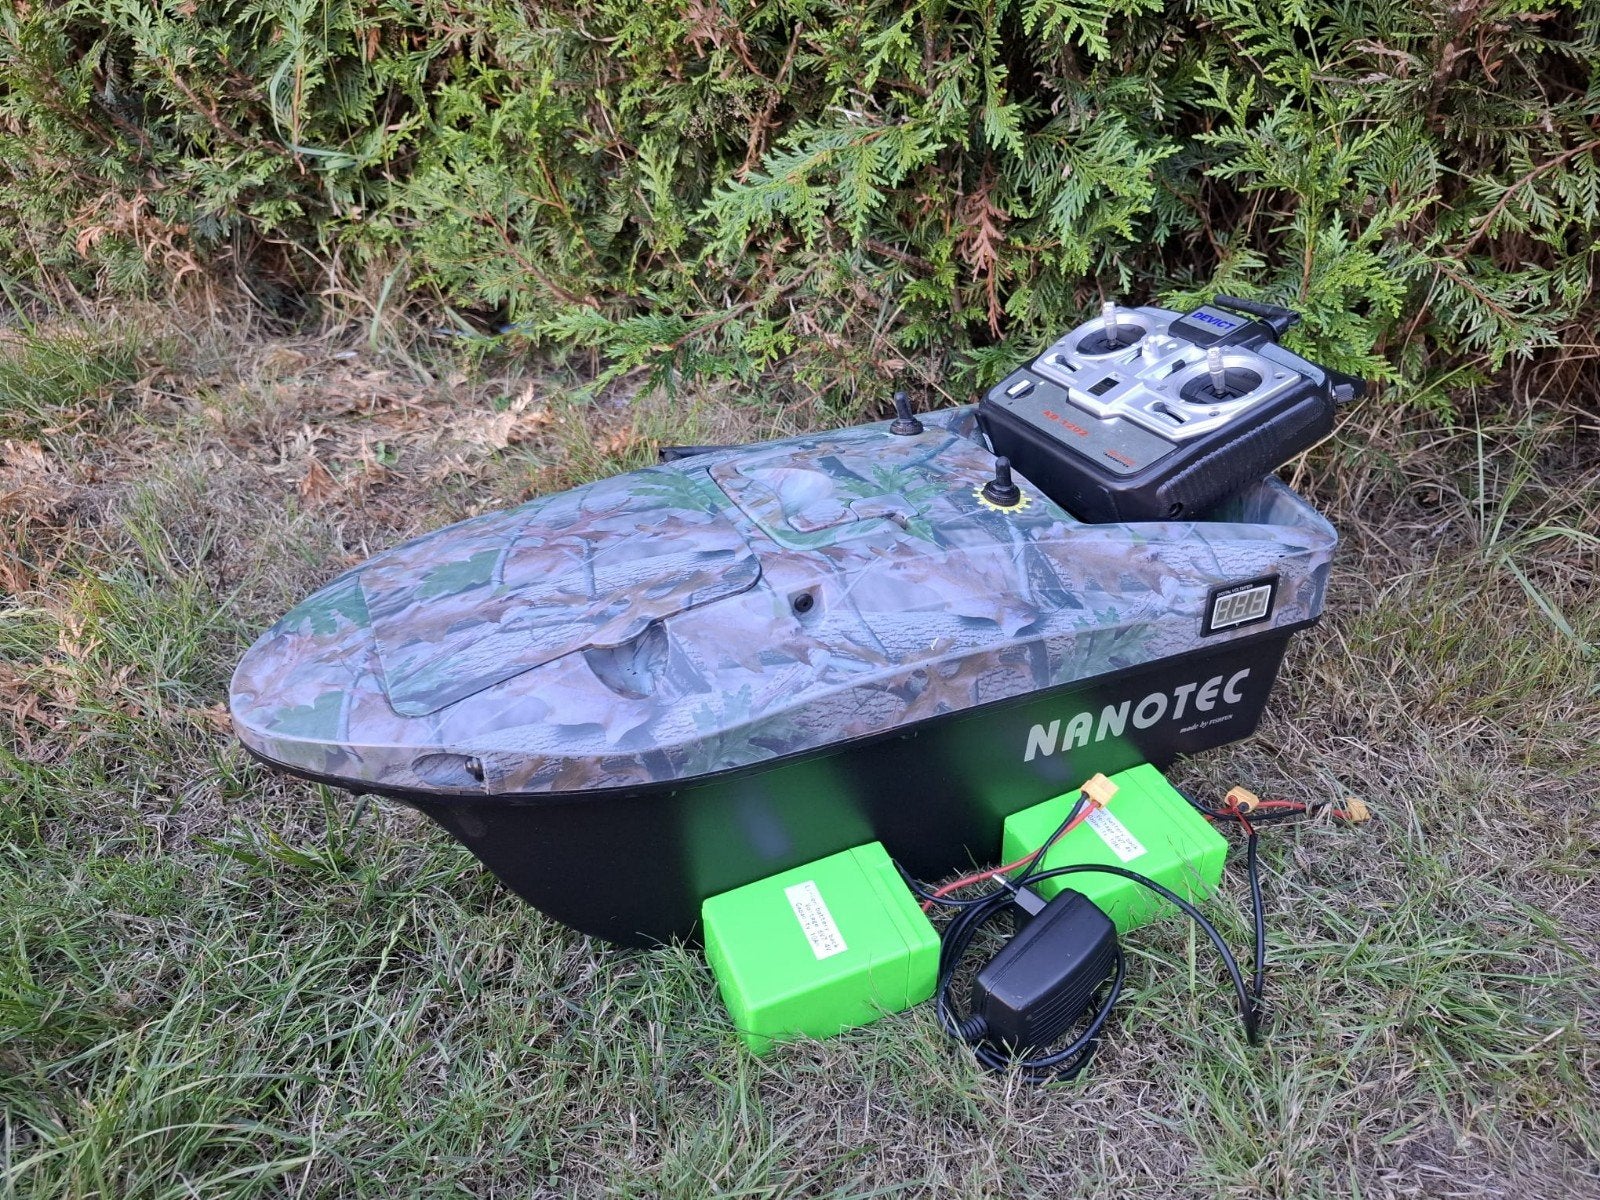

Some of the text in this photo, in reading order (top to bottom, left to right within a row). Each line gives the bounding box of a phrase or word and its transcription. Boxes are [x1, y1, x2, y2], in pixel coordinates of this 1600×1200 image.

[1191, 311, 1237, 330] DEVICT
[1024, 668, 1250, 762] NANOTEC
[1200, 720, 1209, 729] by
